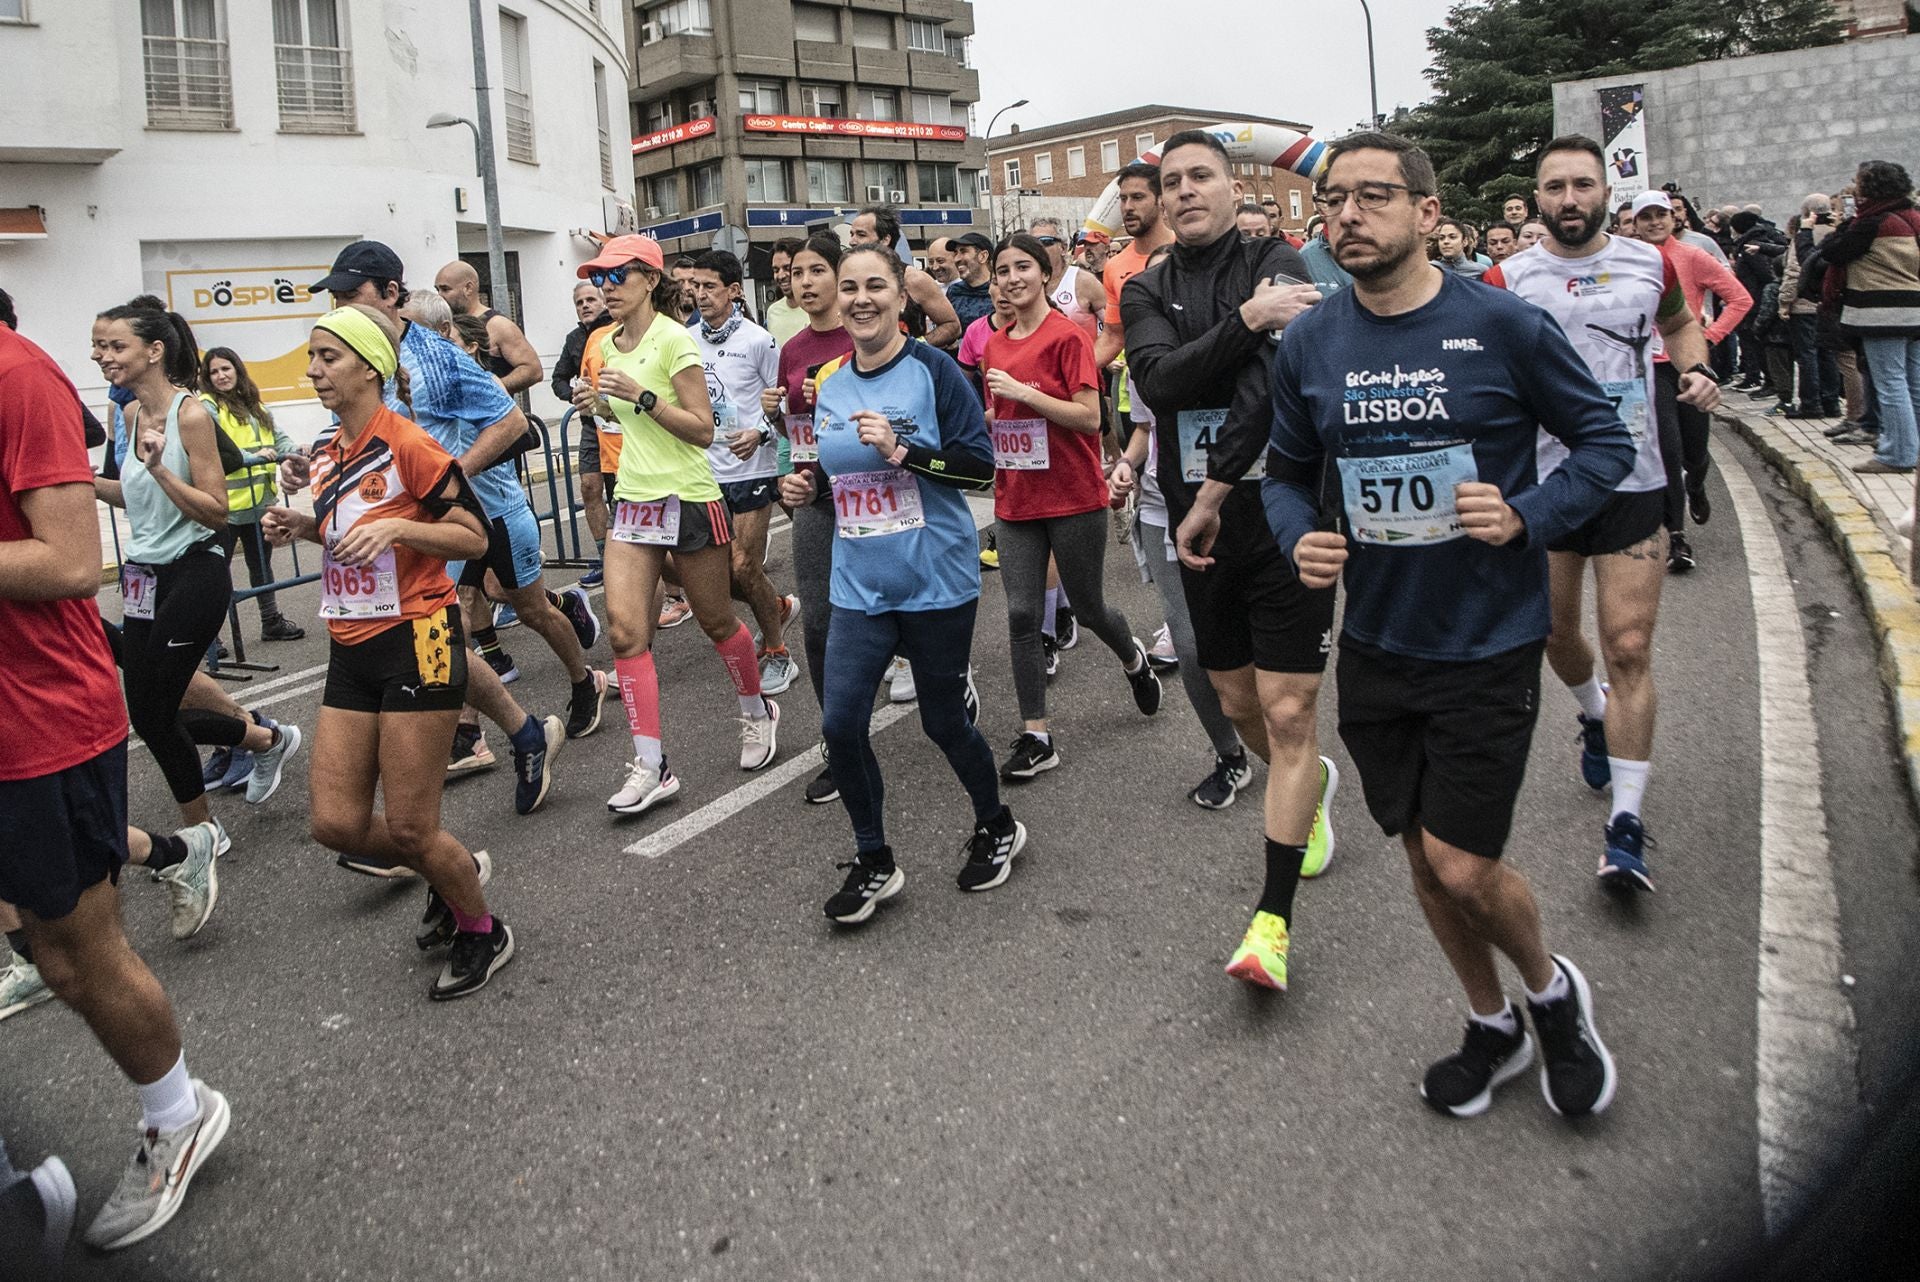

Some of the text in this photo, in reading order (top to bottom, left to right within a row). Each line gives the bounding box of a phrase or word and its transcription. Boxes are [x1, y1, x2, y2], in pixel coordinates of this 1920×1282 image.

[782, 120, 834, 131] Centro Capilar
[1442, 338, 1478, 350] HMS
[1359, 370, 1392, 386] Corte
[1344, 386, 1425, 401] São Silvestre
[1343, 396, 1450, 425] LISBOA
[994, 432, 1032, 454] 1809
[837, 484, 898, 517] 1761
[1360, 475, 1434, 513] 570
[620, 504, 664, 527] 1727
[900, 516, 920, 527] HOY
[325, 566, 376, 597] 1965
[374, 603, 396, 612] HOY
